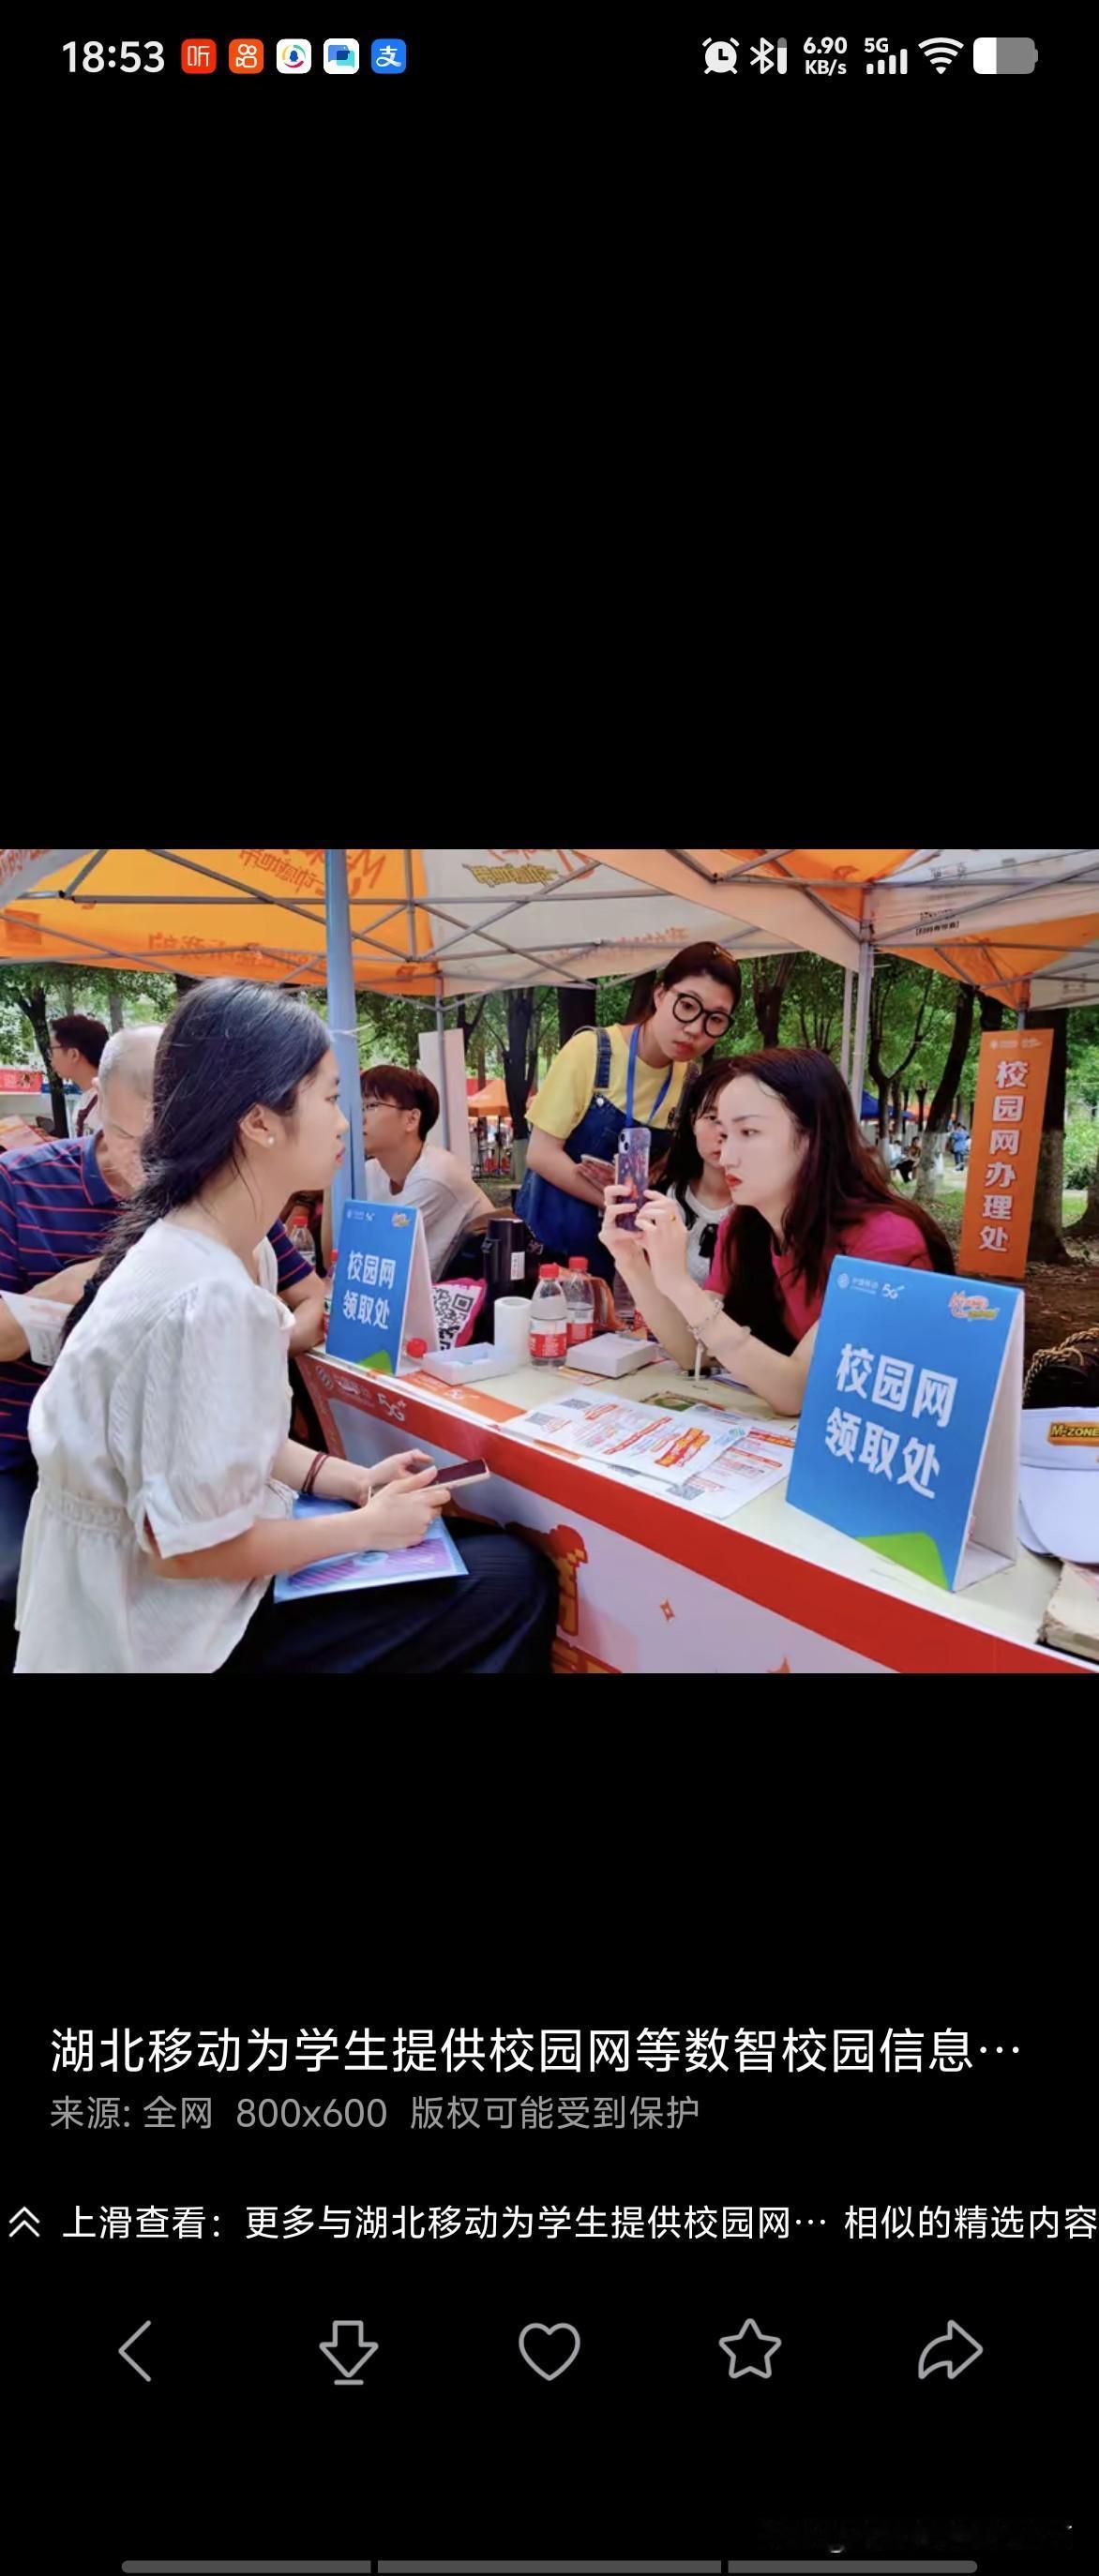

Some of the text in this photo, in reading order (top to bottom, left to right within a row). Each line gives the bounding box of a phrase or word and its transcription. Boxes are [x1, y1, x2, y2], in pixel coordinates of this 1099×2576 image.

[978, 1060, 1029, 1252] 校园网办理处
[342, 1290, 390, 1330] 领取处
[347, 1251, 397, 1290] 校园网
[836, 1343, 957, 1429] 校园网
[824, 1406, 941, 1499] 领取处
